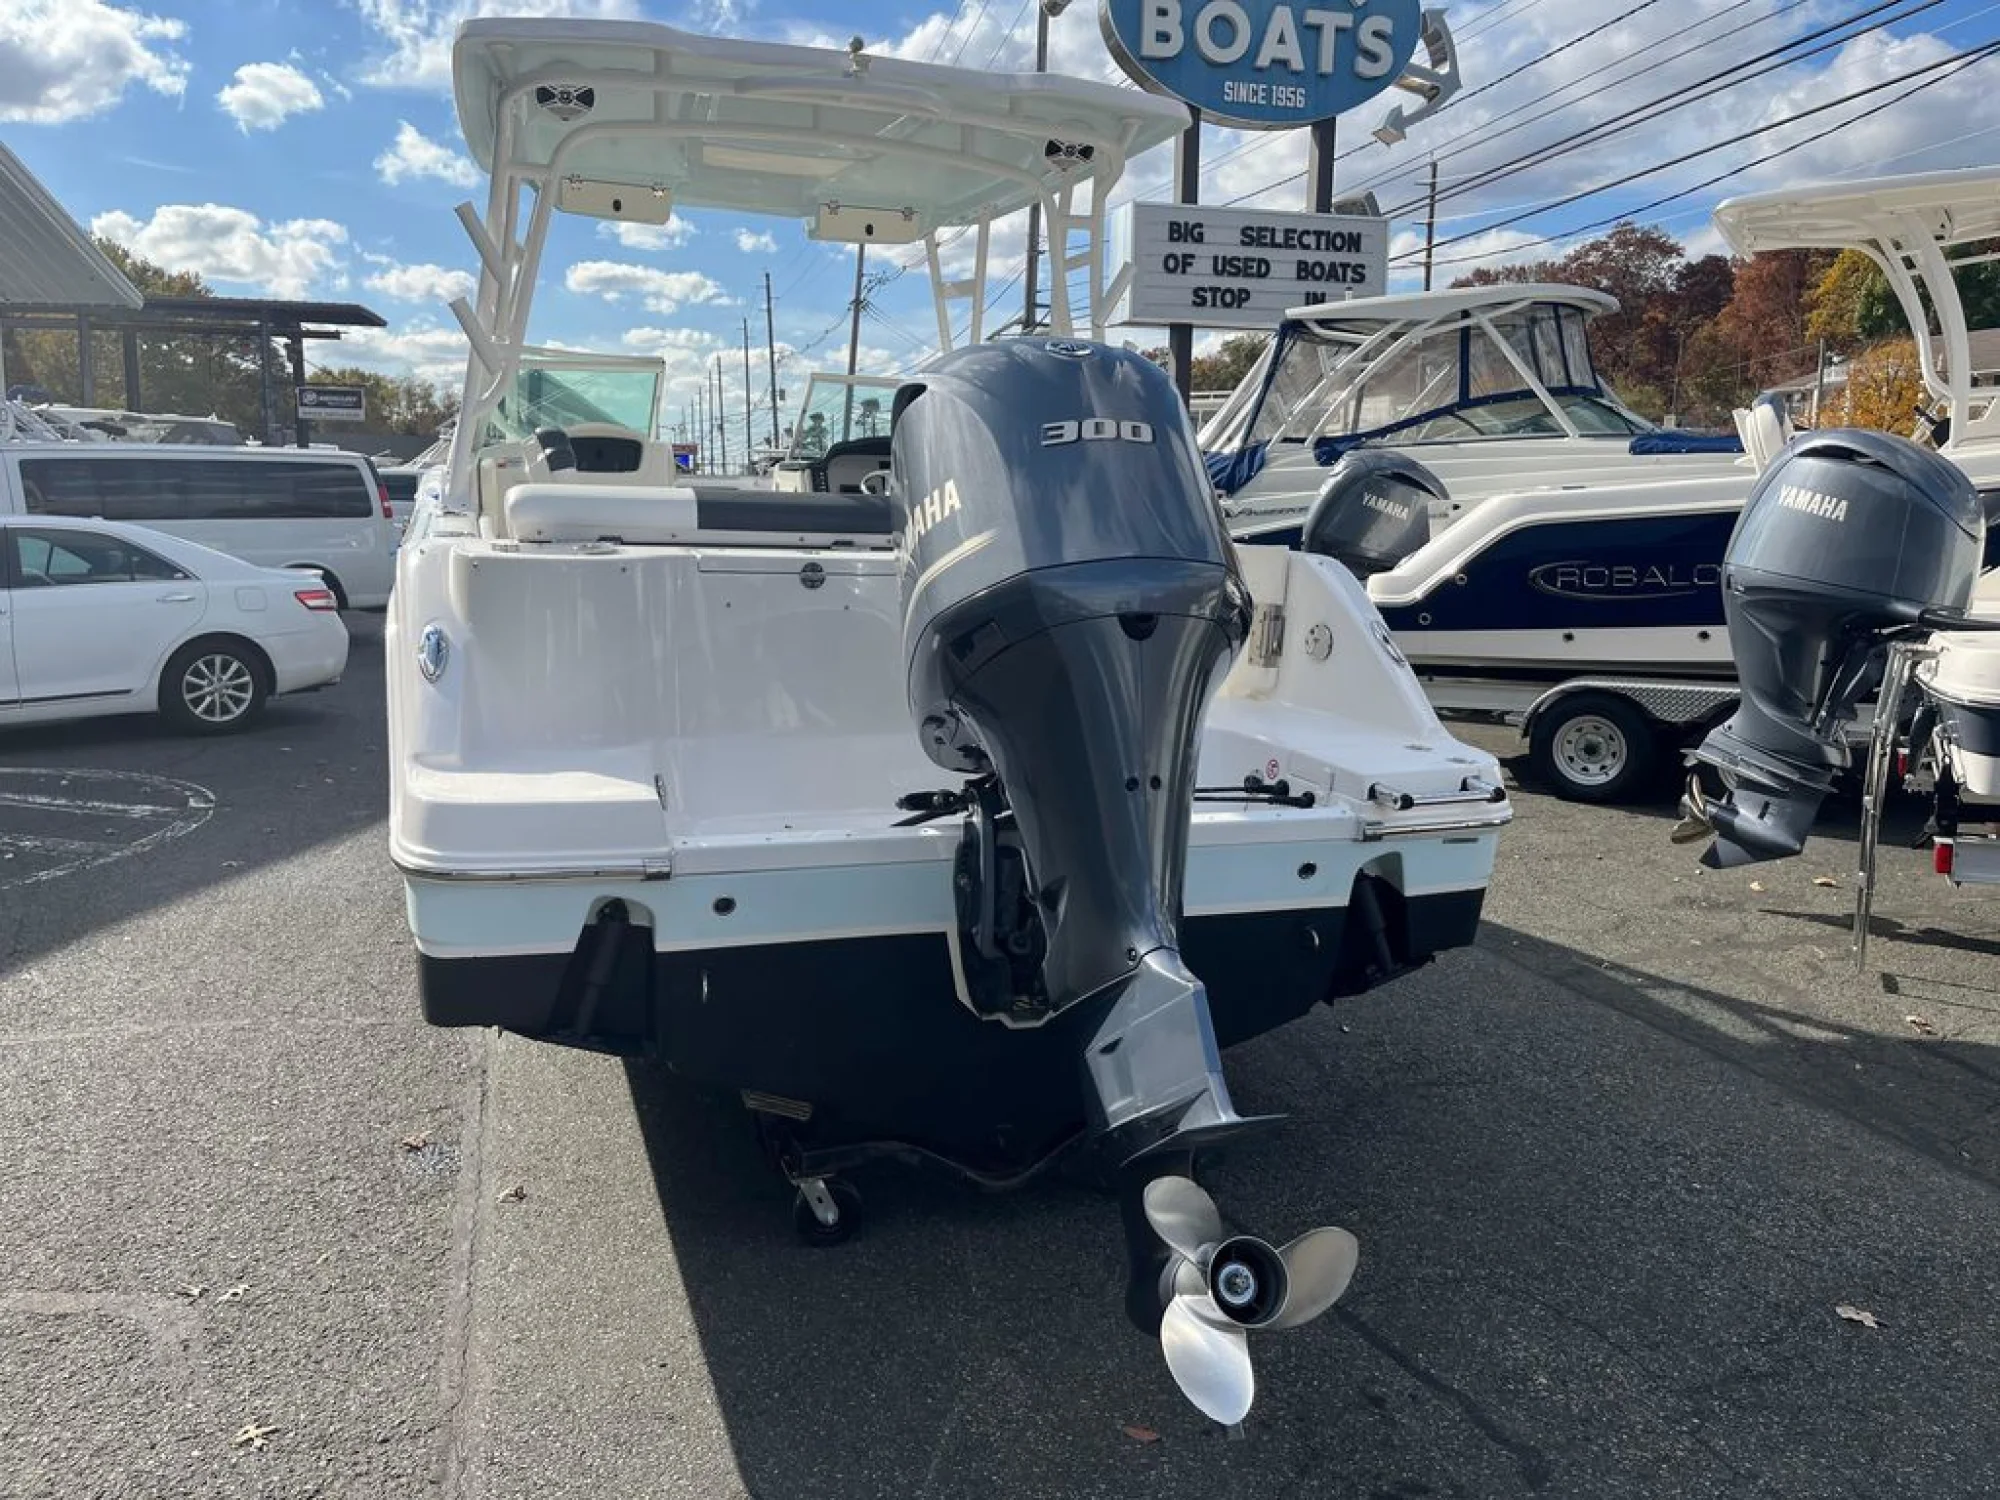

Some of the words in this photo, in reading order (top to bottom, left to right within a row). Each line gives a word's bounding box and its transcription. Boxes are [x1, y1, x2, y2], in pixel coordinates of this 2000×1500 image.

[1140, 0, 1395, 78] BOATS
[1223, 81, 1267, 105] SINCE
[1271, 85, 1306, 108] 1956
[1168, 220, 1204, 244] BIG
[1239, 225, 1362, 253] SELECTION
[1163, 253, 1196, 275] OF
[1212, 255, 1271, 279] USED
[1296, 259, 1366, 284] BOATS
[1191, 286, 1251, 309] STOP
[1040, 417, 1155, 447] 300
[1362, 491, 1410, 521] YAMAHA
[1779, 483, 1849, 522] YAMAHA
[1556, 564, 1722, 588] ROBALO
